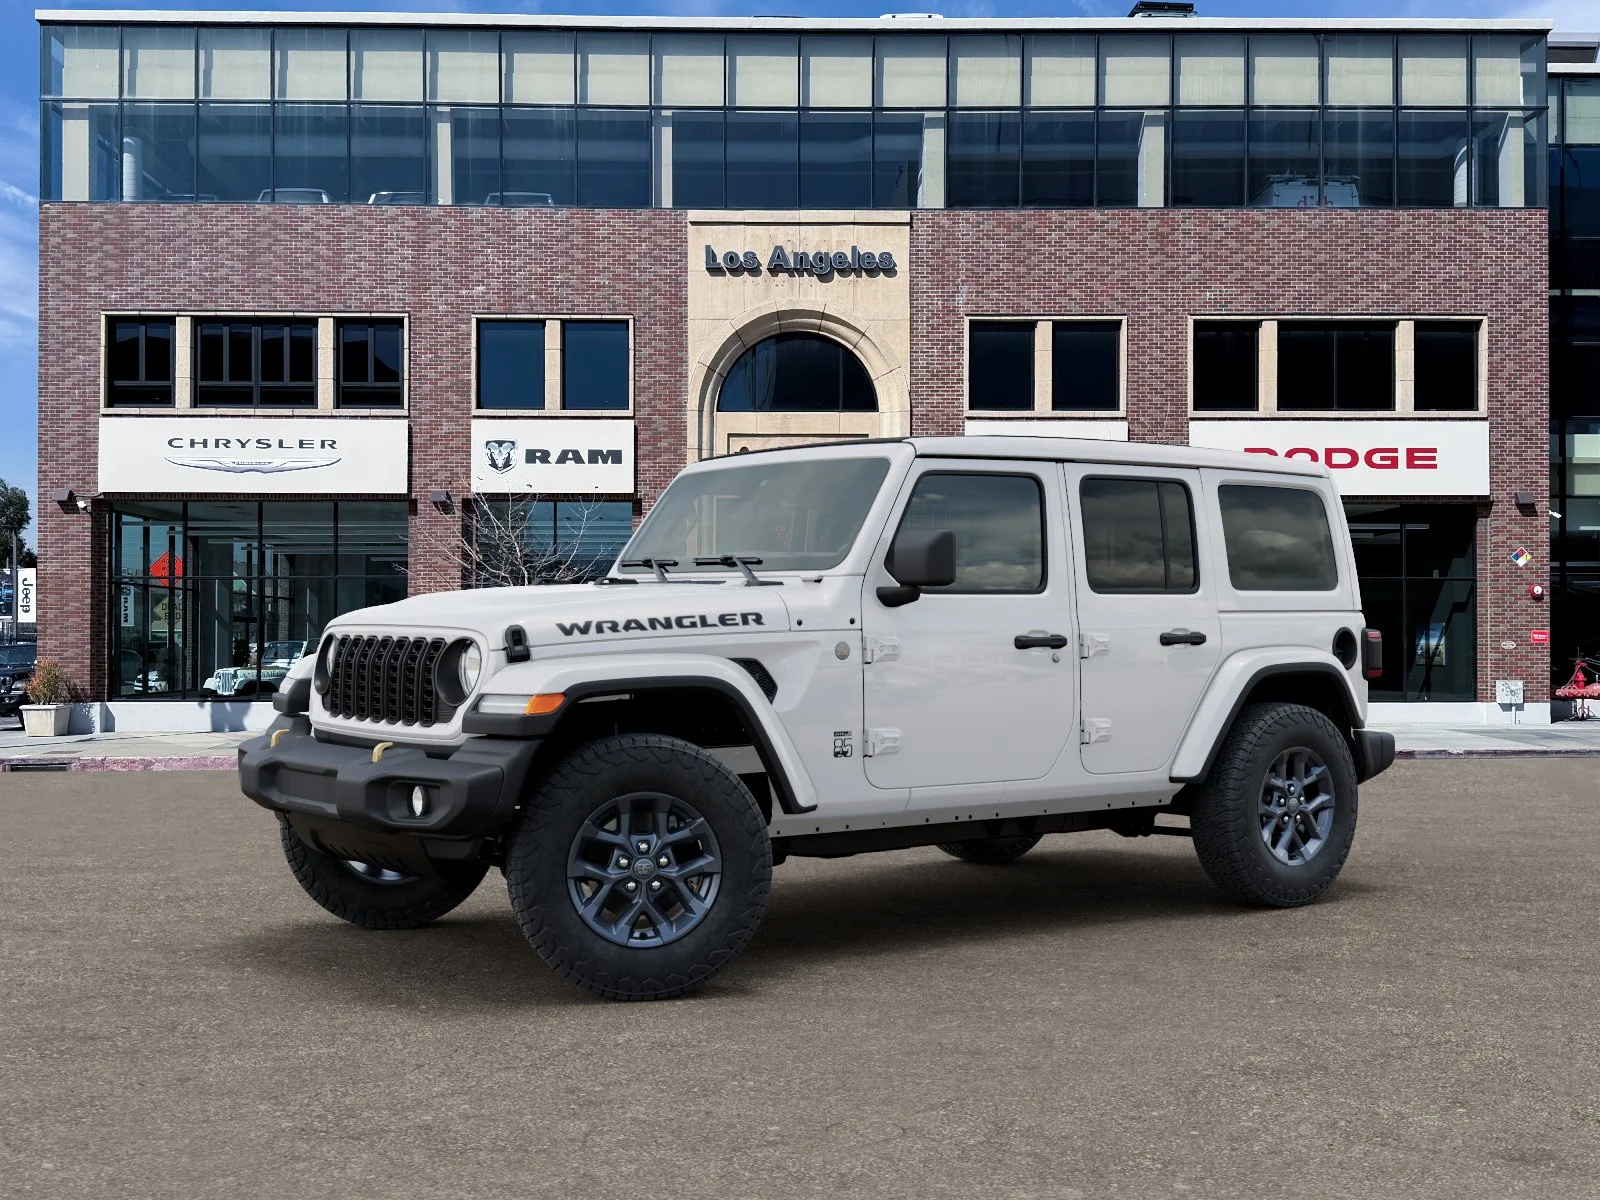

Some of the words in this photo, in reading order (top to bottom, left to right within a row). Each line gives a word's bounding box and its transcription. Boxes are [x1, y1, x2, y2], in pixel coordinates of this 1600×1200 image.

[704, 244, 758, 270] Los
[767, 245, 895, 275] Angeles
[167, 437, 337, 450] CHRYSLER
[525, 448, 623, 465] RAM
[20, 577, 33, 613] Jeep
[555, 612, 765, 636] WRANGLER
[833, 738, 853, 758] 85
